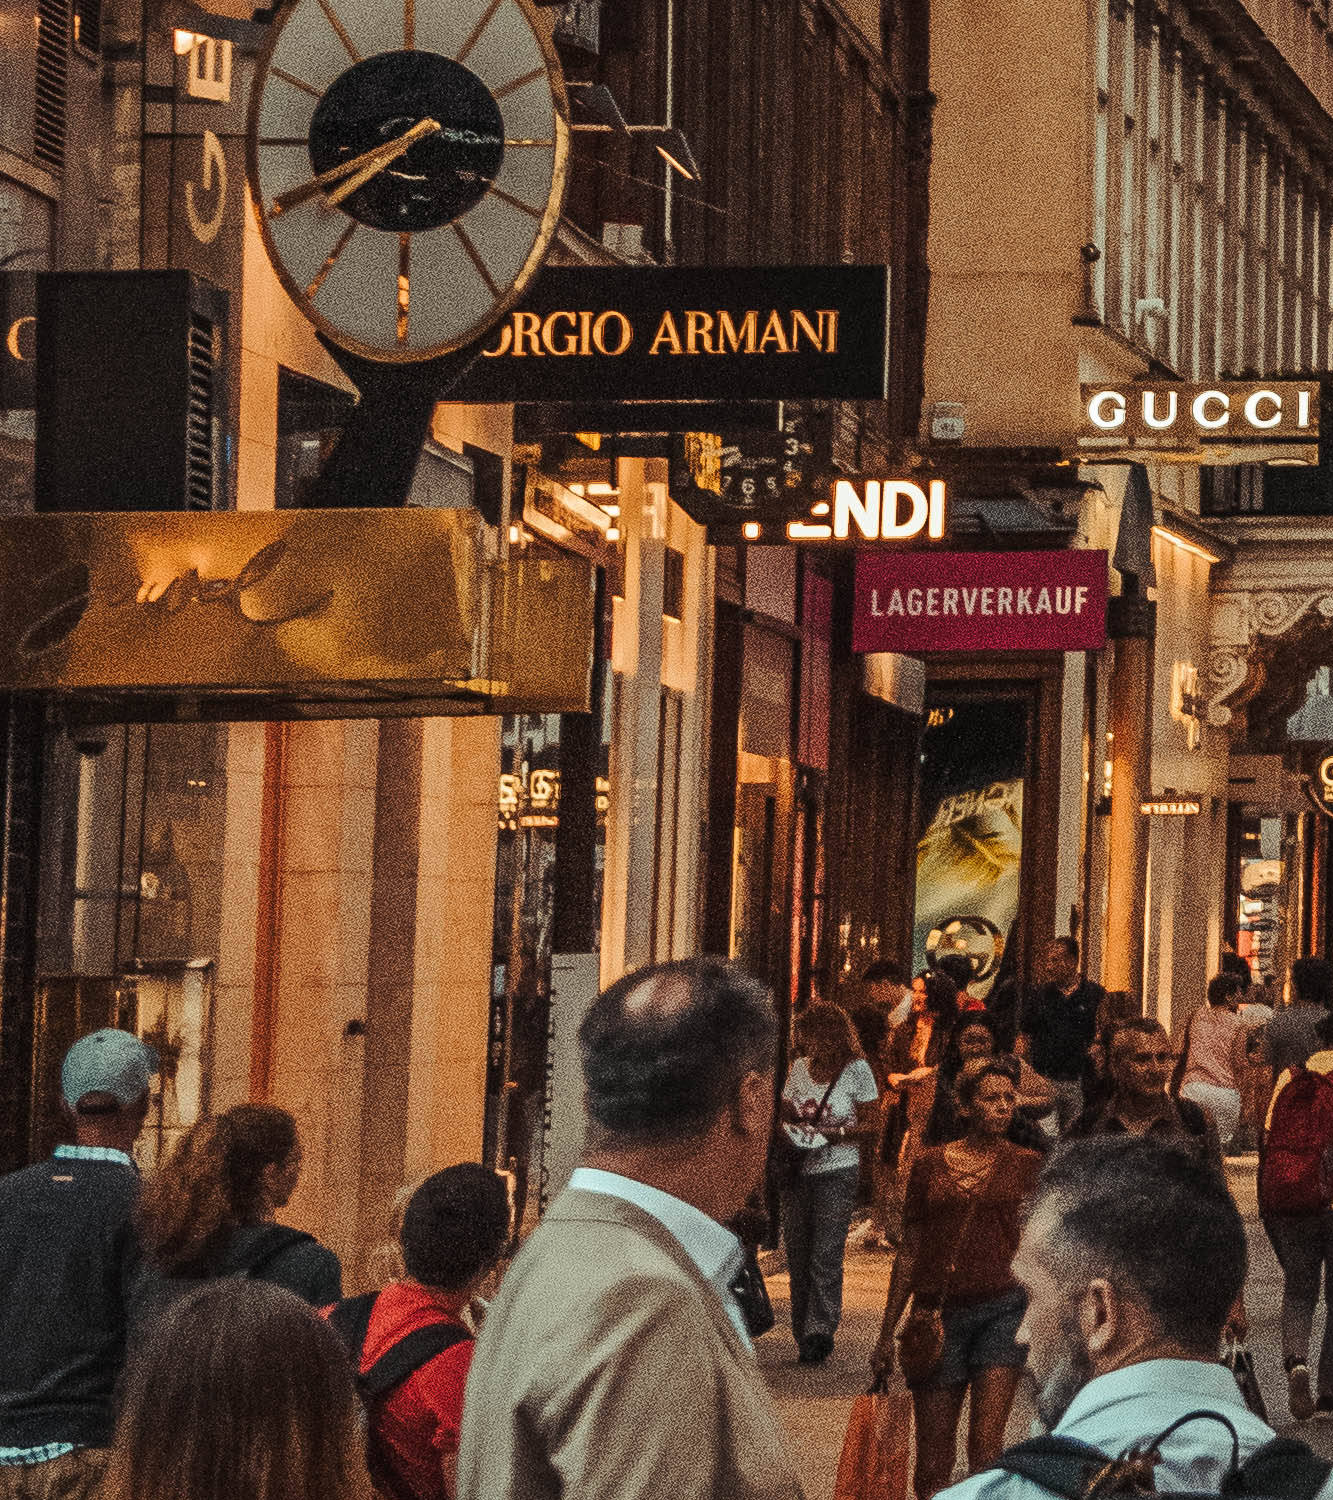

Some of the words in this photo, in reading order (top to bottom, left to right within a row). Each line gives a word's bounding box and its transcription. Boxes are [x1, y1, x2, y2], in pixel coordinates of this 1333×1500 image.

[649, 309, 840, 355] ARMANI
[1088, 389, 1311, 430] GUCCI
[871, 586, 1089, 617] LAGERVERKAUF
